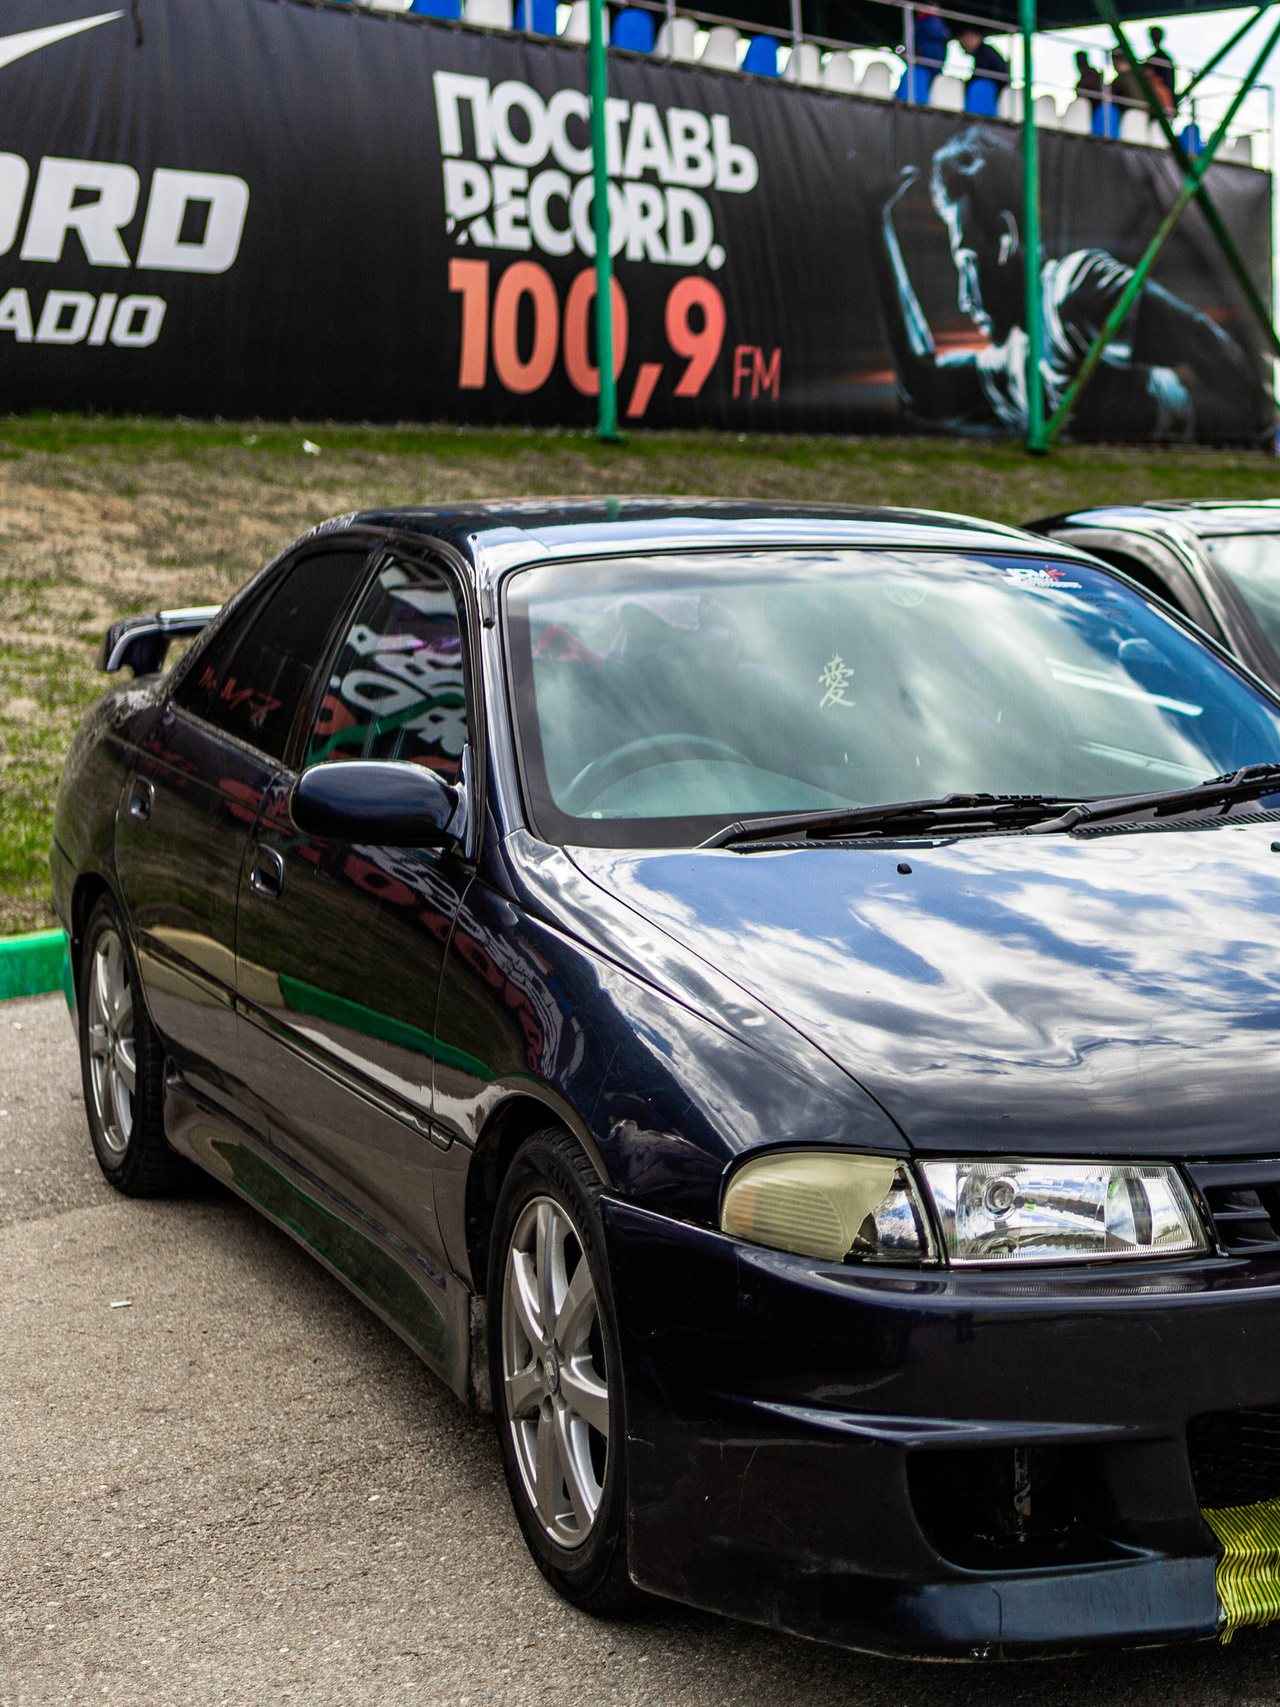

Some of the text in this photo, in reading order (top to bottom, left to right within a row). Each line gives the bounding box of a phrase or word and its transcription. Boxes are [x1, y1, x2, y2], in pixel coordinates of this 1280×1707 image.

[433, 70, 759, 194] ПОСТАВЬ
[442, 158, 727, 271] RECORD.
[449, 257, 782, 418] 100,9 FM
